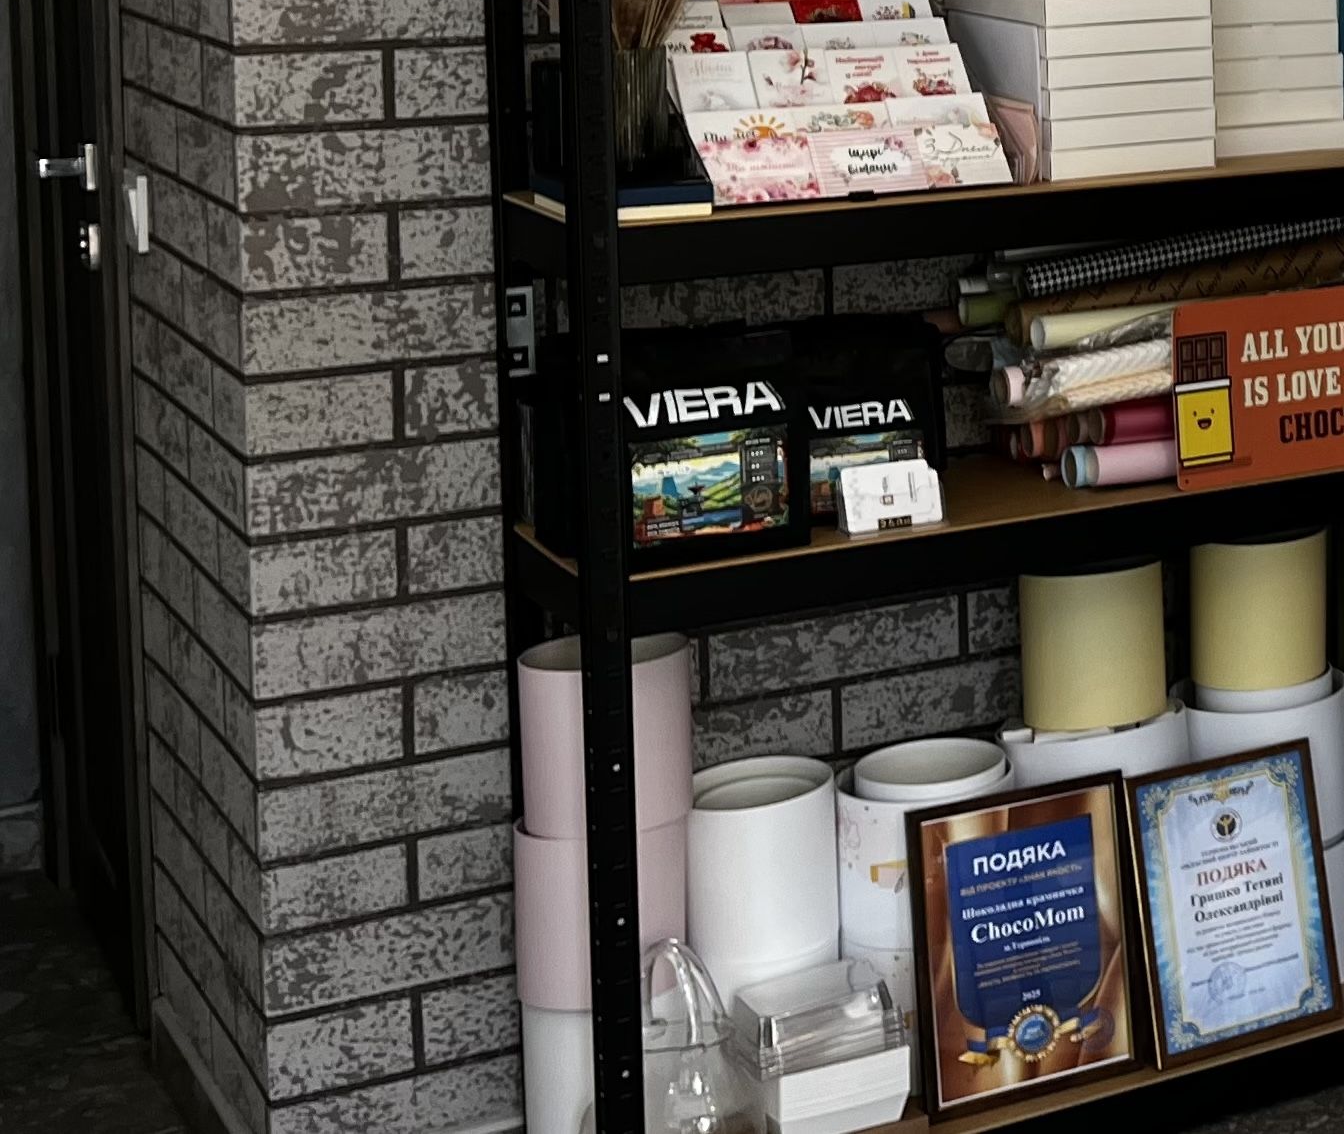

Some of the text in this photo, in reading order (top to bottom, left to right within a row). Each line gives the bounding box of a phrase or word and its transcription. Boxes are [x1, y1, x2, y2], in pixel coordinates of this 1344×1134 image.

[1241, 329, 1288, 362] ALL
[622, 381, 783, 428] VIERA
[1243, 376, 1269, 408] IS
[1276, 366, 1341, 402] LOVE
[808, 398, 913, 430] VIERA
[972, 840, 1067, 876] ПОДЯКА
[1196, 858, 1268, 887] ПОДЯКА
[962, 886, 1085, 921] Шоколадна крамничка
[1190, 872, 1284, 908] Гришко Тетяні
[1194, 889, 1285, 924] Олександрівні
[970, 905, 1086, 944] ChocoMom
